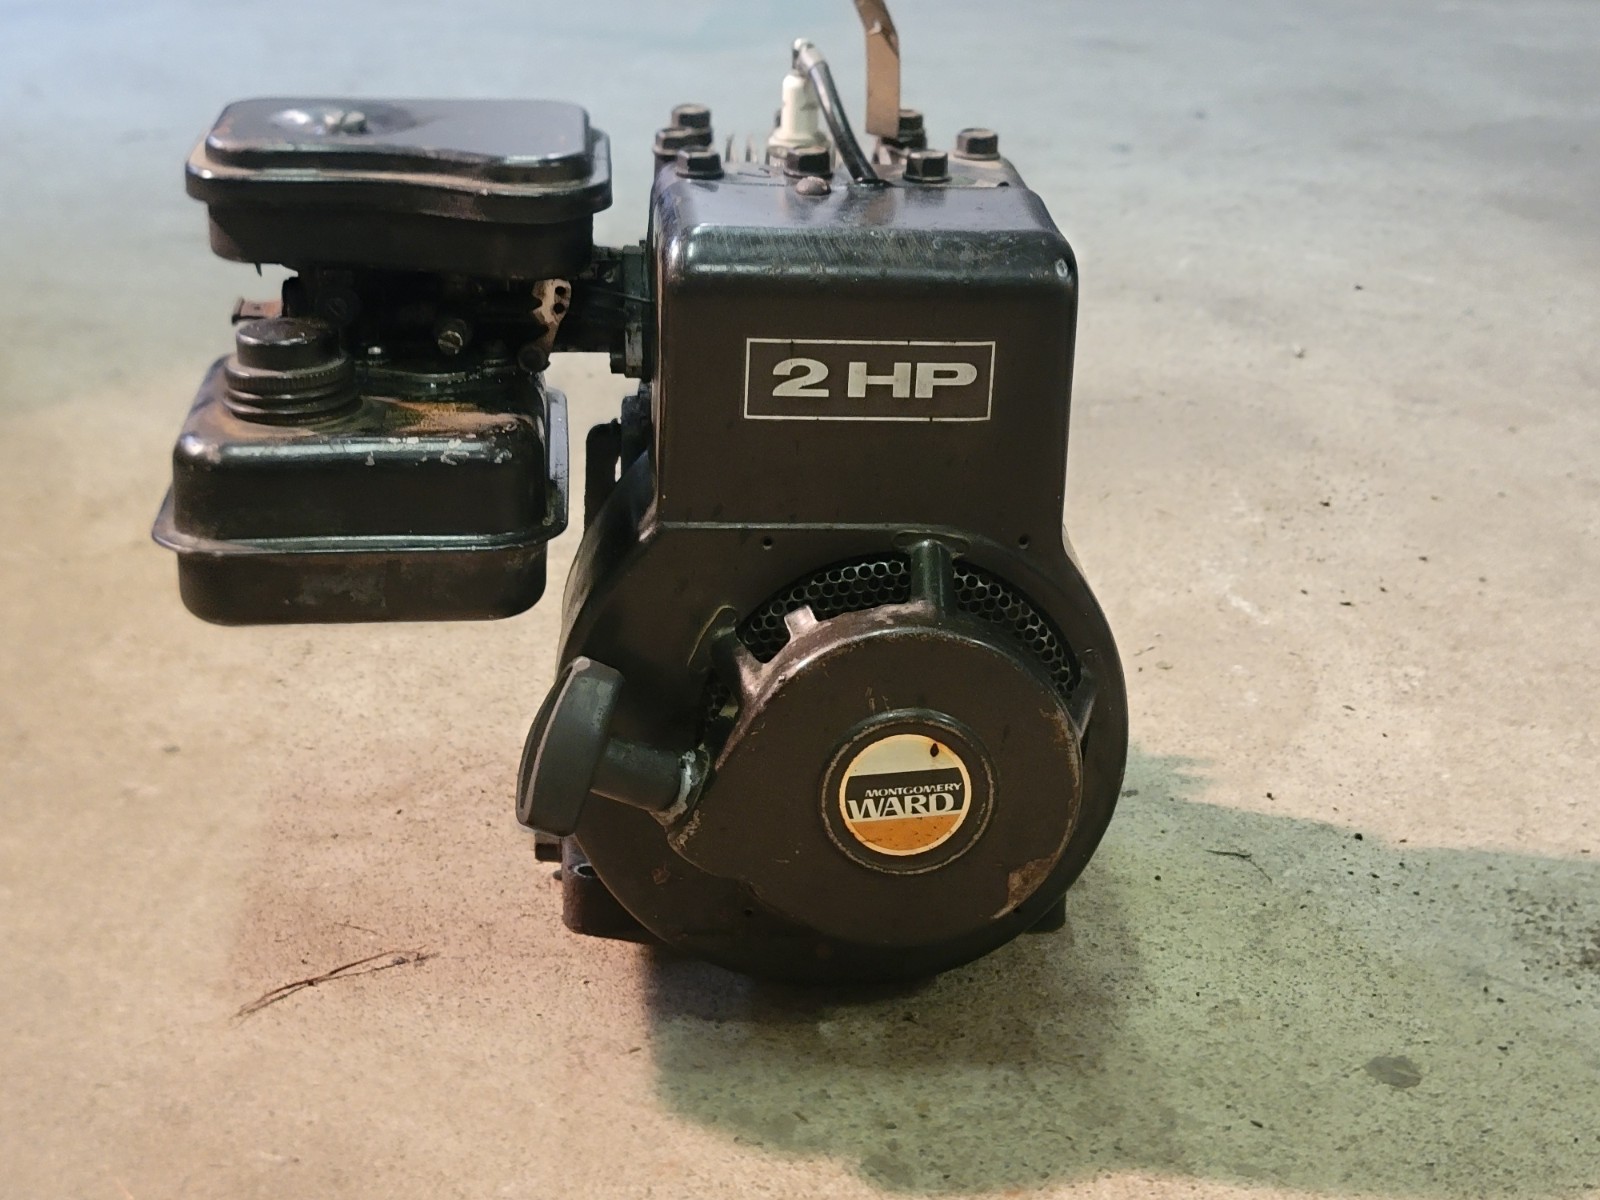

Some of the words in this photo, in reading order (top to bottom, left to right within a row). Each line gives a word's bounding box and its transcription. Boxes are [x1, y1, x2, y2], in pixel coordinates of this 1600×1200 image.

[772, 357, 829, 397] 2
[847, 361, 978, 398] HP
[865, 782, 962, 797] MONTGOMERY
[847, 792, 954, 820] WARD
